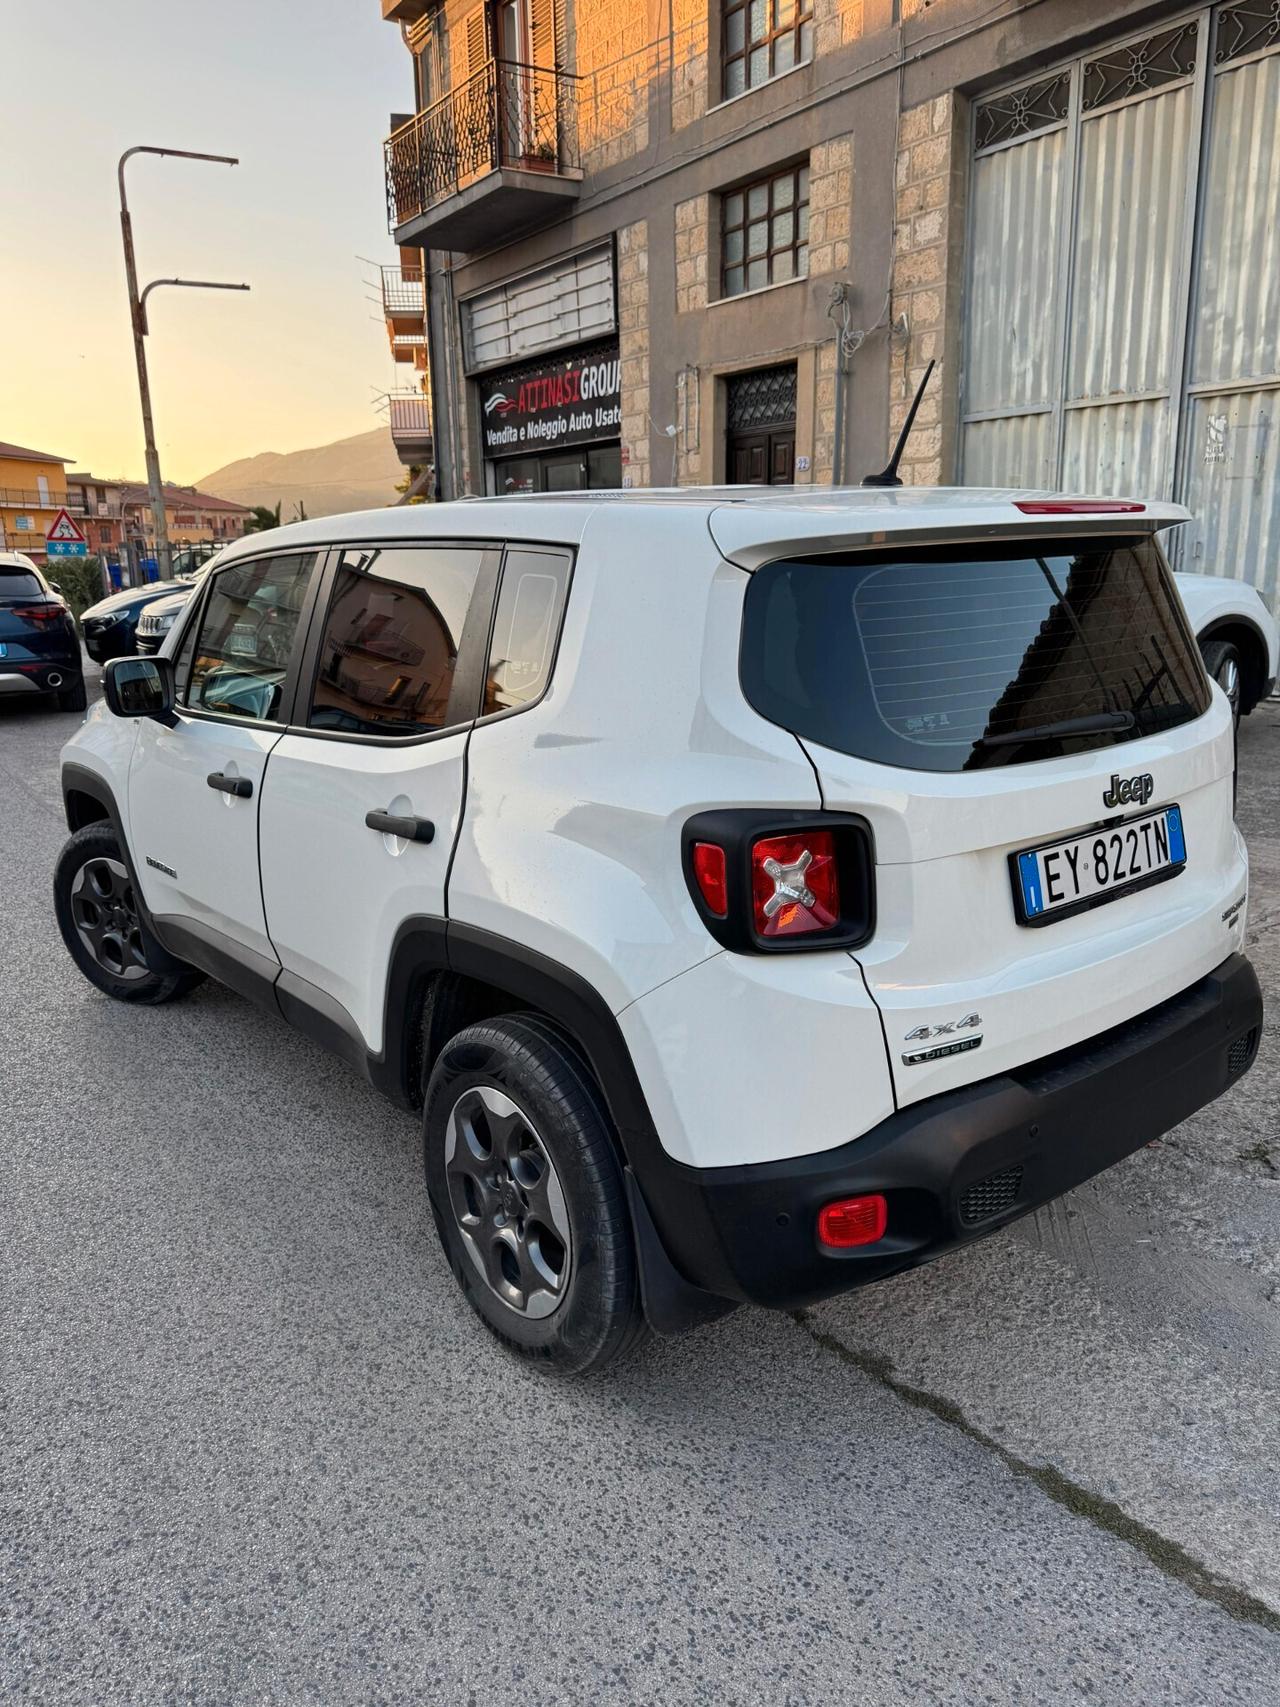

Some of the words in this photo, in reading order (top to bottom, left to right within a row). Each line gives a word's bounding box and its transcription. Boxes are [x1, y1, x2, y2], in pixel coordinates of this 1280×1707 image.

[486, 426, 519, 446] Vendita
[519, 429, 525, 441] e
[527, 416, 567, 440] Noleggio
[569, 412, 593, 432] Auto
[1103, 773, 1154, 808] Jeep
[1043, 845, 1080, 903] EY
[1092, 818, 1170, 885] 822TN
[925, 1040, 979, 1059] DIESEL
